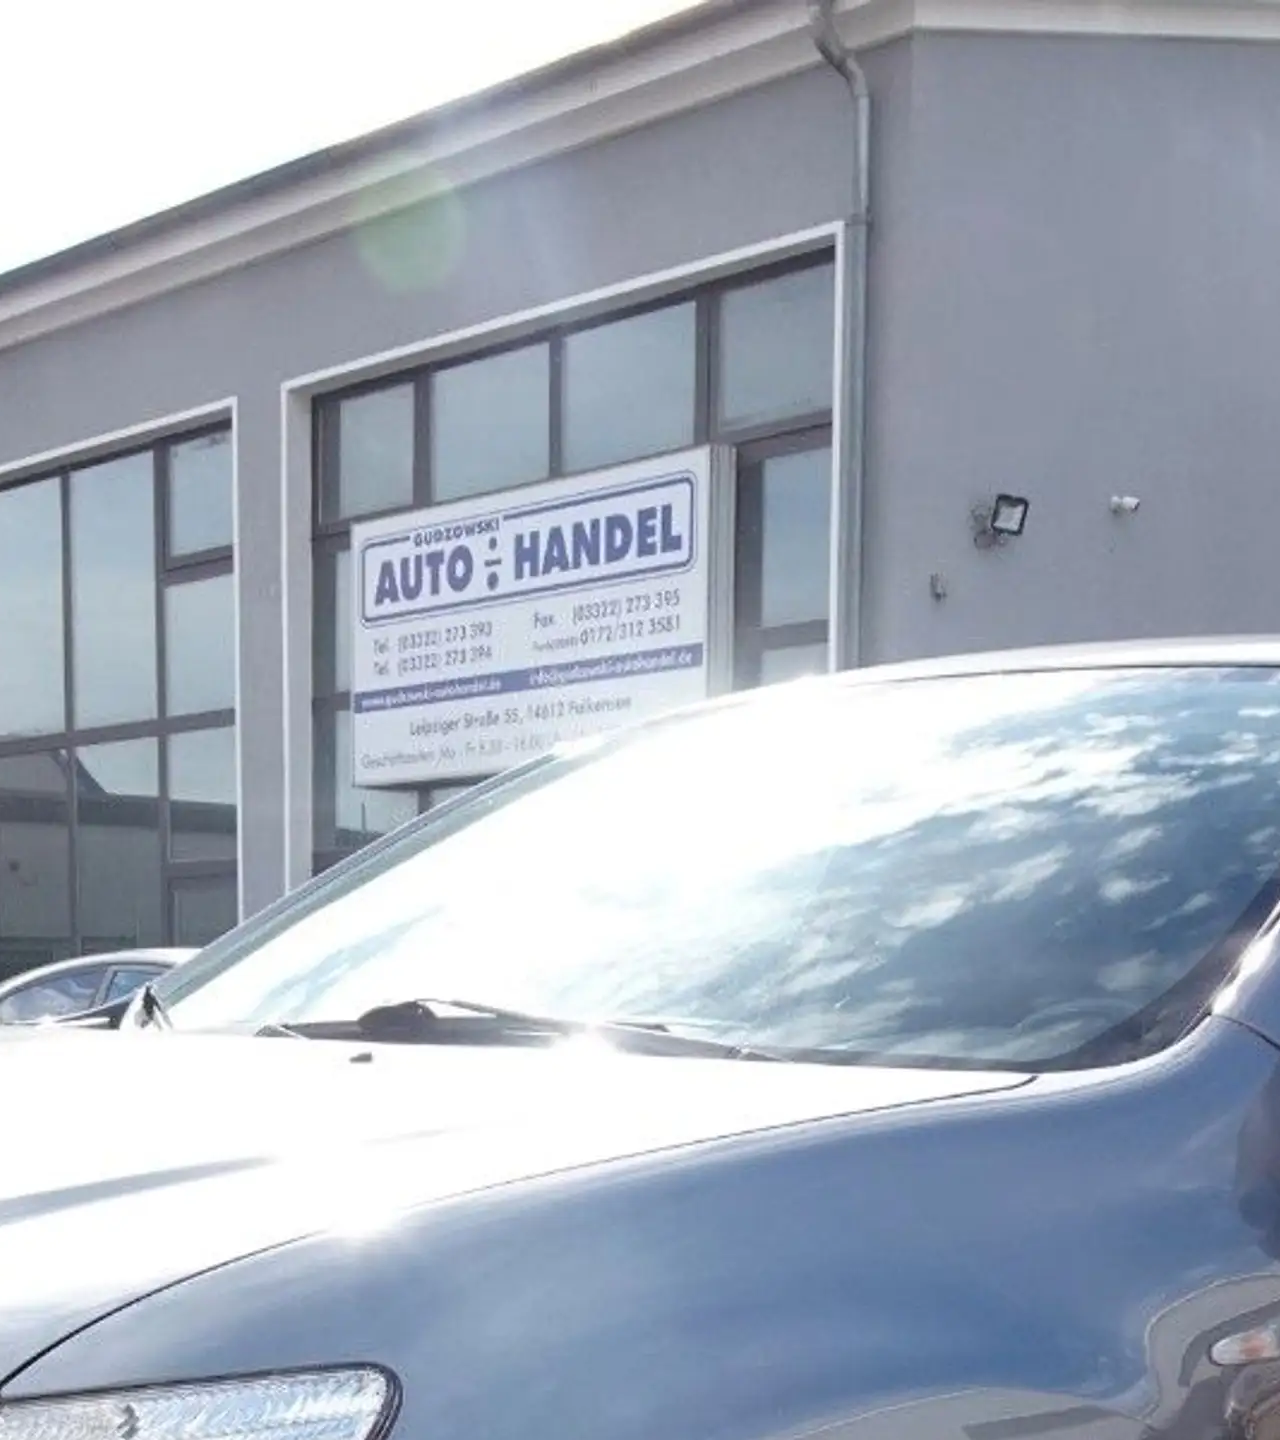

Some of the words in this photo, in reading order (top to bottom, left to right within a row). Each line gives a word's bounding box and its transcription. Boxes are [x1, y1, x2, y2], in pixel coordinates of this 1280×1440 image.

[374, 544, 474, 607] AUTO
[514, 503, 682, 581] HANDEL
[409, 714, 462, 737] Leipziger
